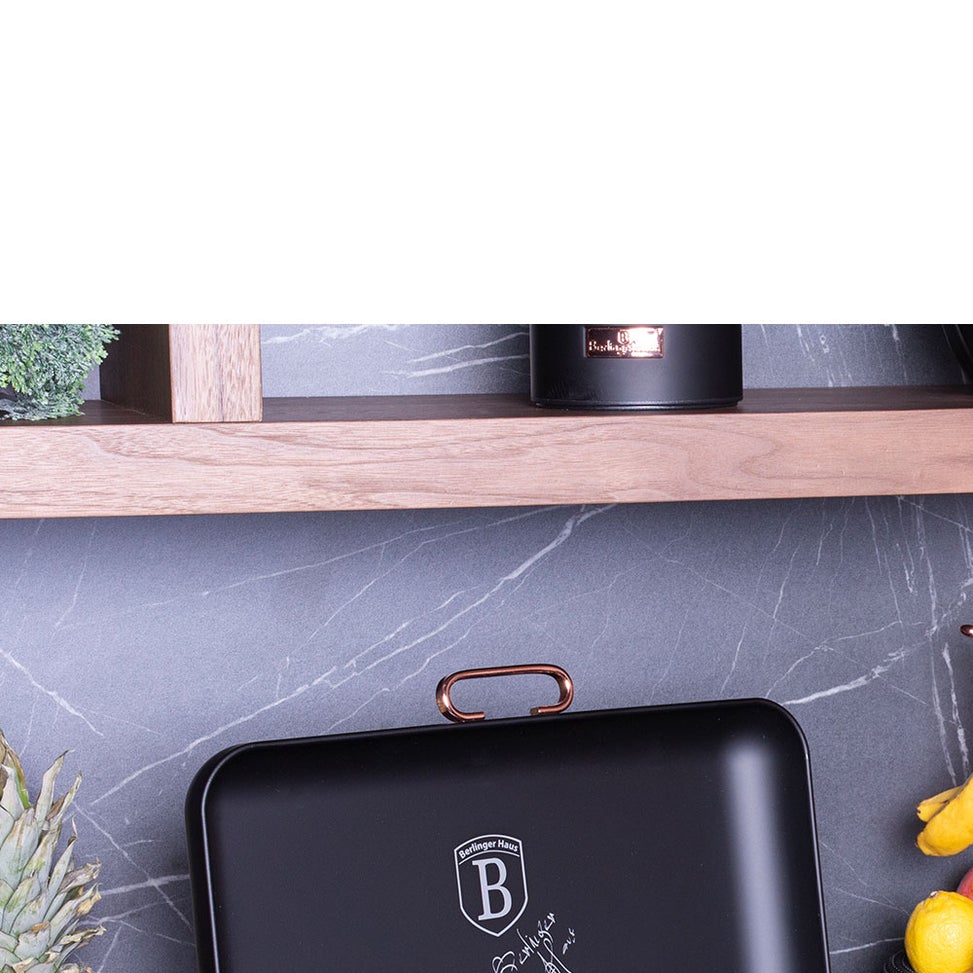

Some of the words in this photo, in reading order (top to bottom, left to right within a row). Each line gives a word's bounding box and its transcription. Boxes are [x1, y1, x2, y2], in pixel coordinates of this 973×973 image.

[458, 841, 497, 859] Berlinger
[497, 839, 519, 853] Haus
[471, 857, 513, 921] B
